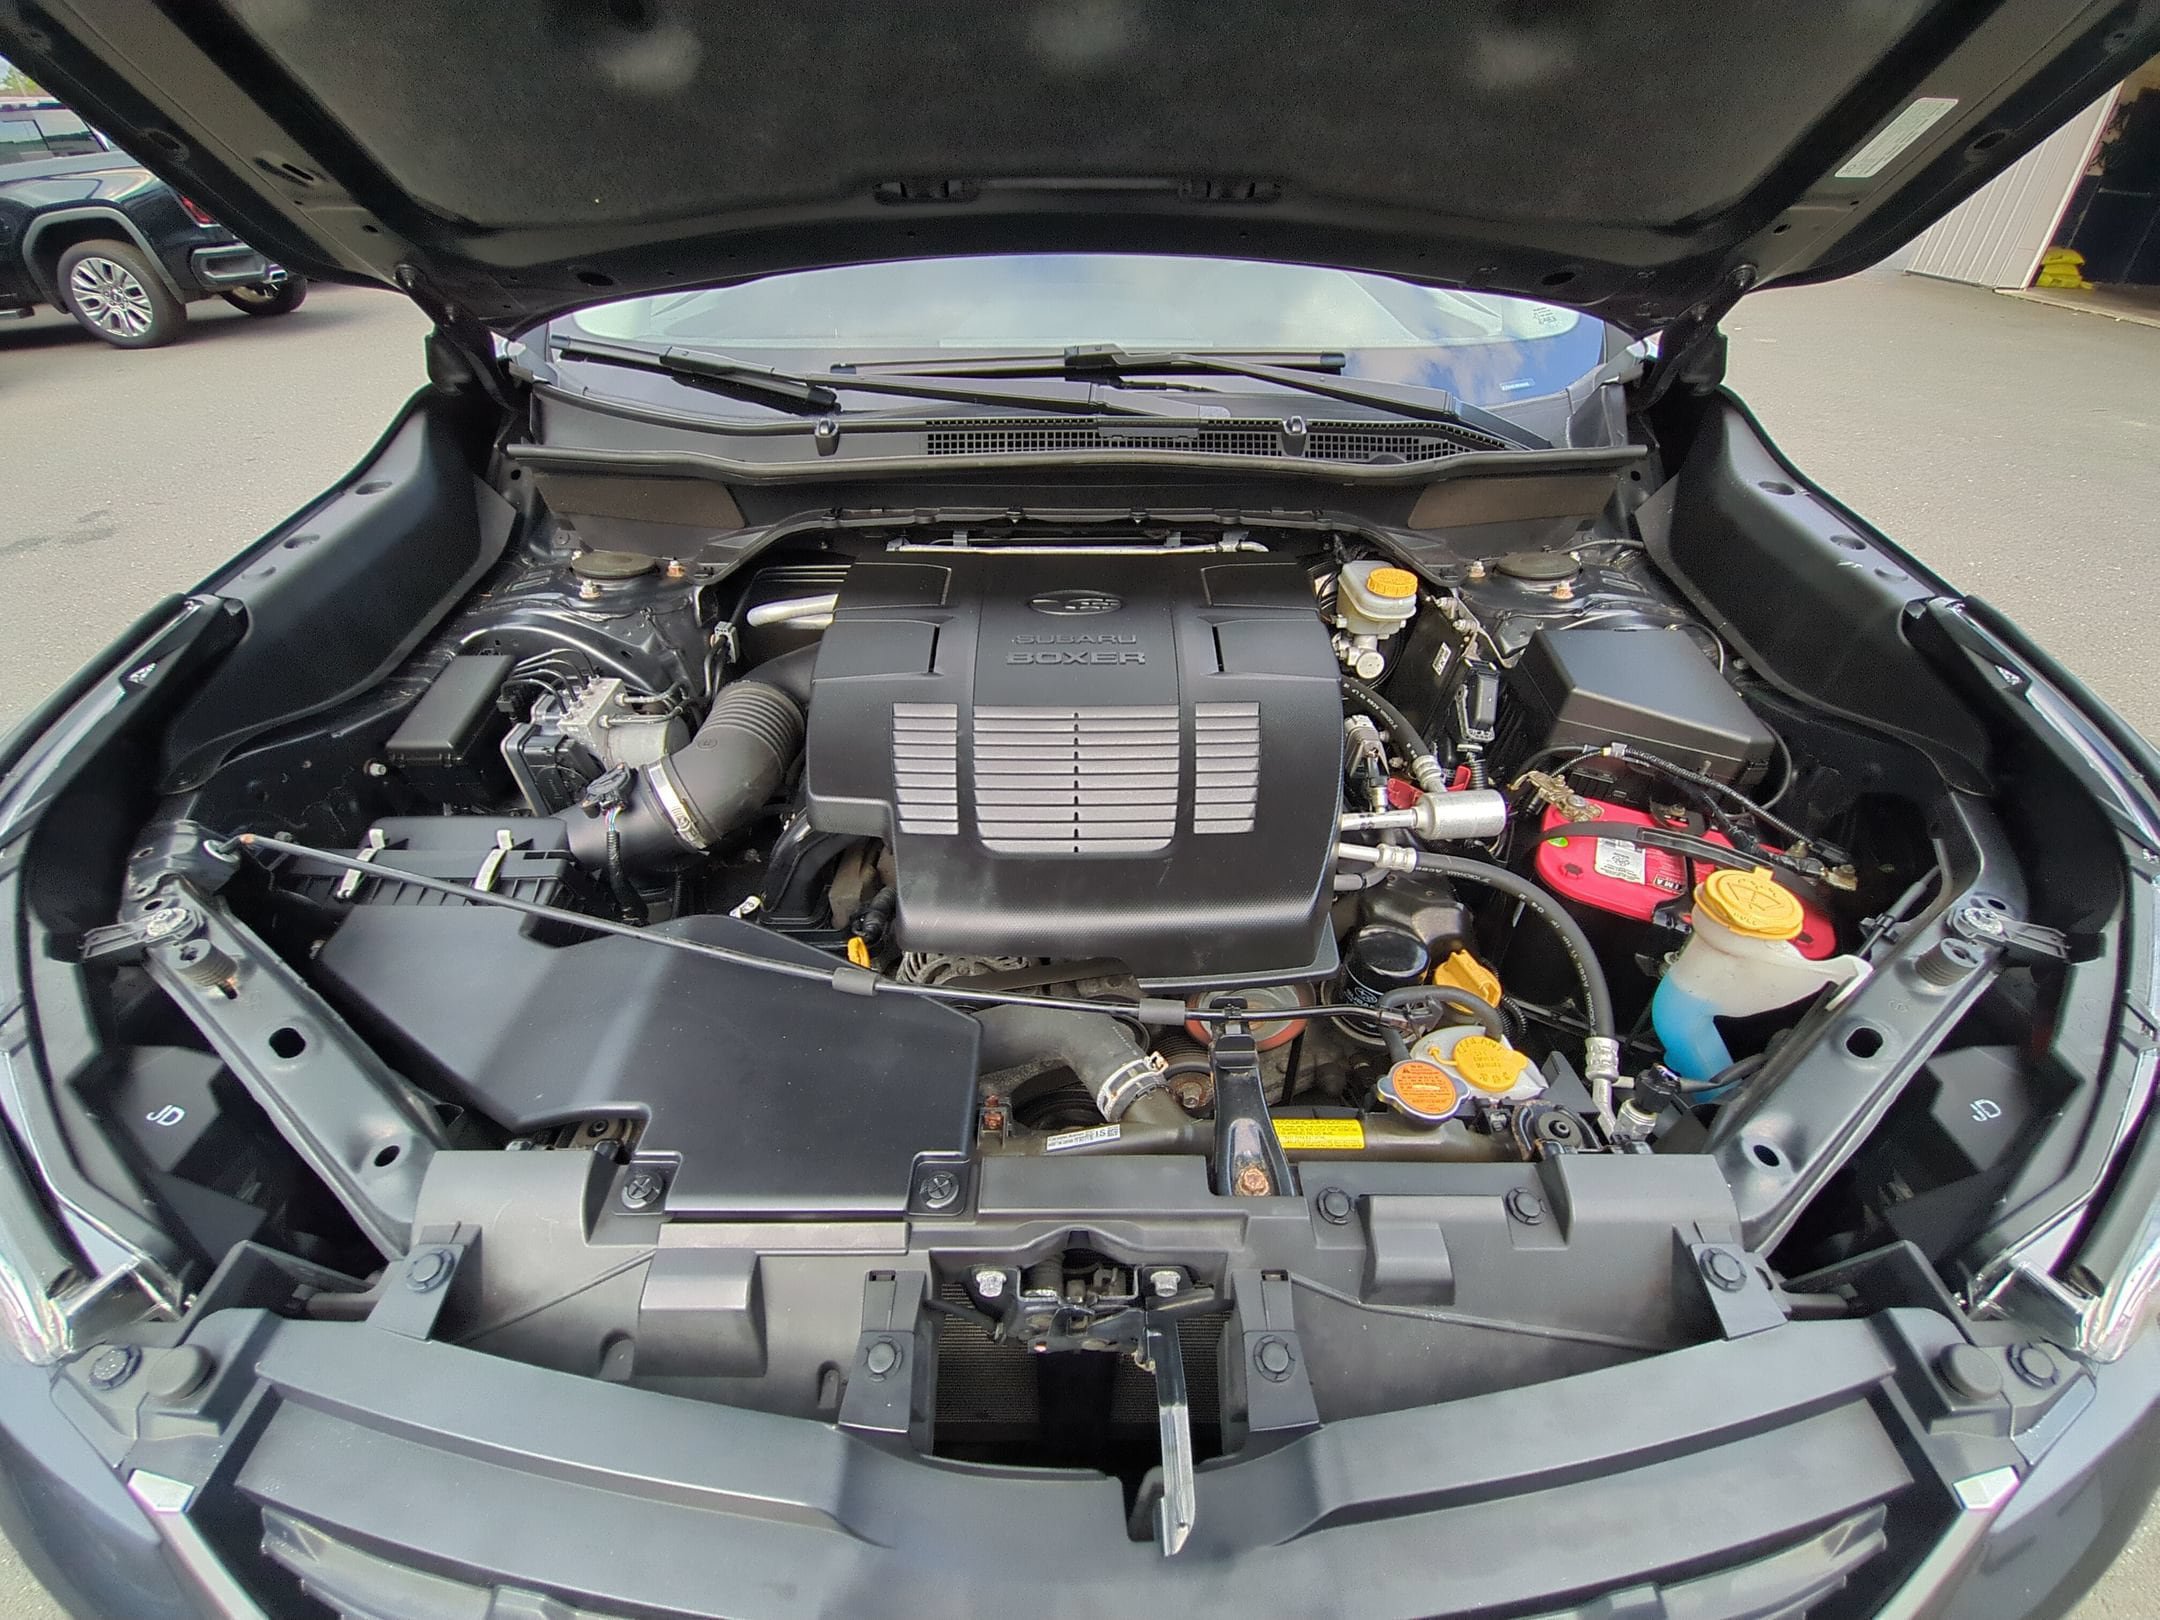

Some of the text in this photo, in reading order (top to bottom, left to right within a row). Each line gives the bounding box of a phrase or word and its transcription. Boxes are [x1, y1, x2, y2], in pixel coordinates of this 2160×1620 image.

[1015, 634, 1137, 645] SUBARU
[1006, 651, 1146, 665] BOXER
[146, 1104, 186, 1127] JD
